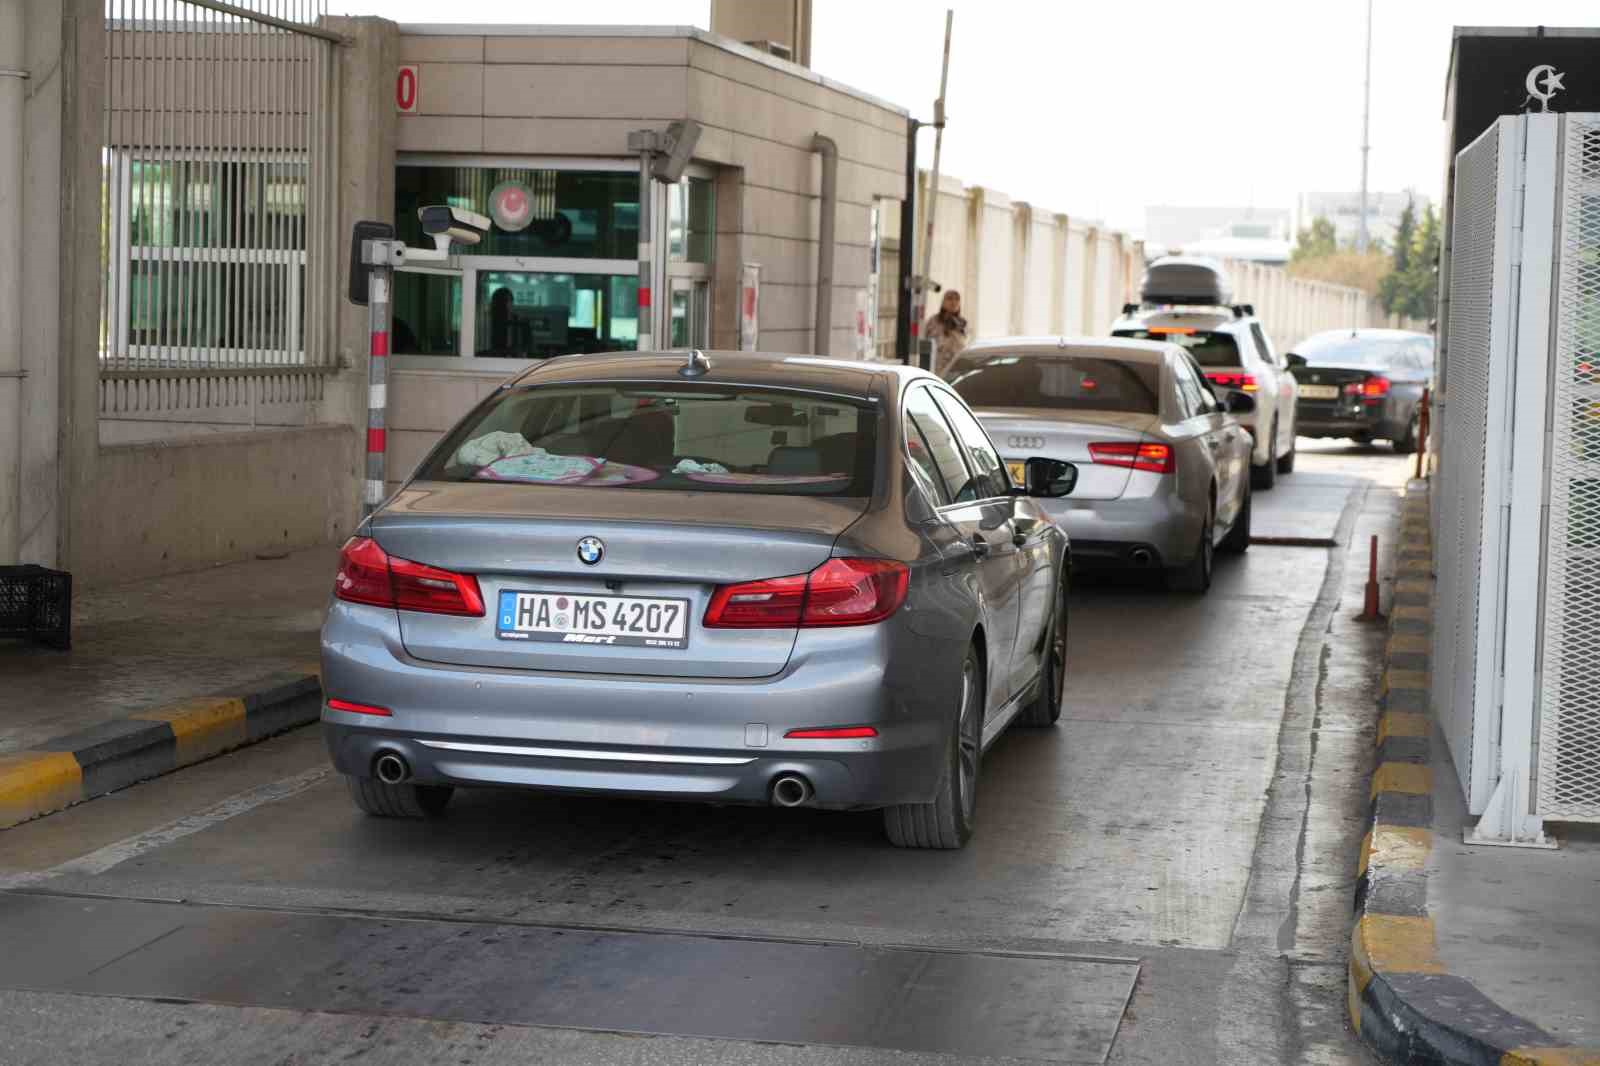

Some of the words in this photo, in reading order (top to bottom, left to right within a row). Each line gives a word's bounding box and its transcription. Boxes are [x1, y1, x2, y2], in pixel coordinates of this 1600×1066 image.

[504, 615, 511, 625] D
[518, 597, 551, 628] HA
[573, 600, 607, 630] MS
[612, 603, 680, 634] 4207
